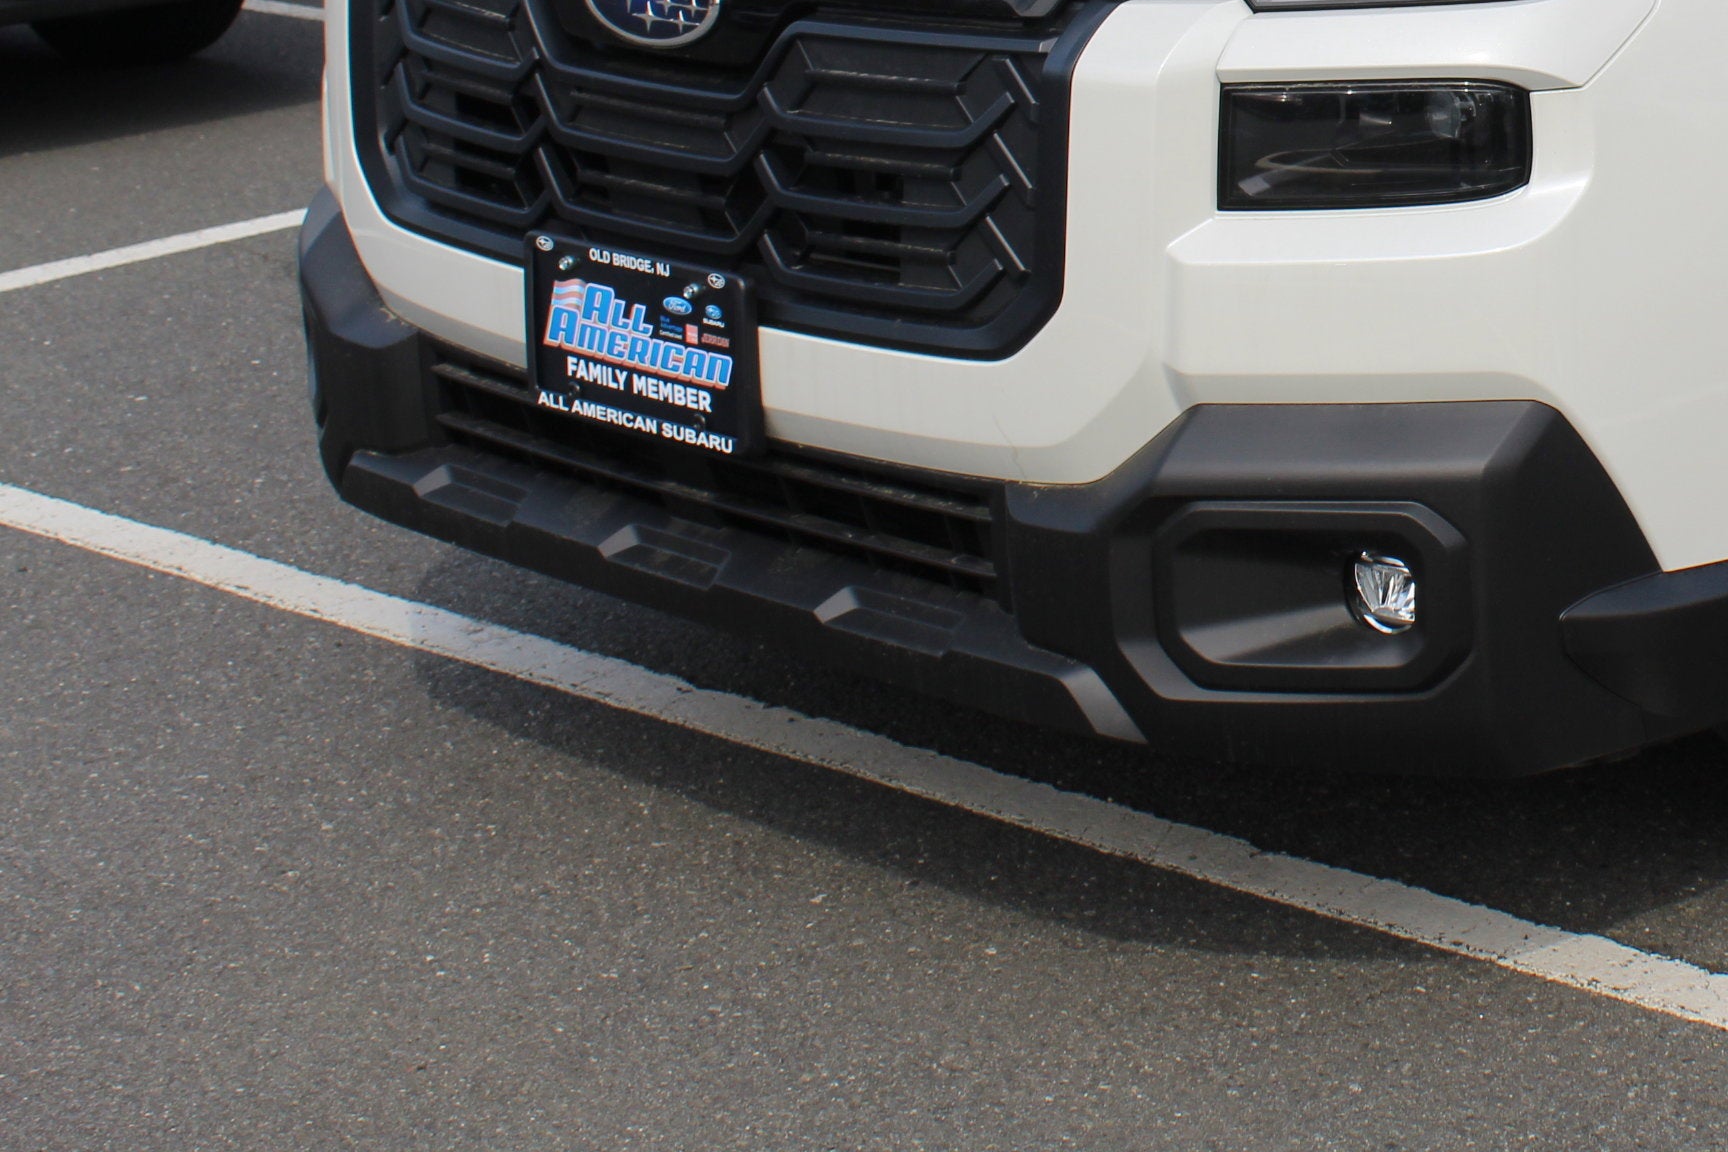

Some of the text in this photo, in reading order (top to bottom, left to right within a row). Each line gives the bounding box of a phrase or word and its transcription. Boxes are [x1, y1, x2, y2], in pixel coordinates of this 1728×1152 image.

[589, 247, 670, 277] OLD BRIDGE, NJ
[581, 282, 654, 337] ALL
[544, 305, 733, 388] AMERICAN
[566, 355, 712, 413] FAMILY MEMBER
[537, 391, 733, 454] ALL AMERICAN SUBARU
